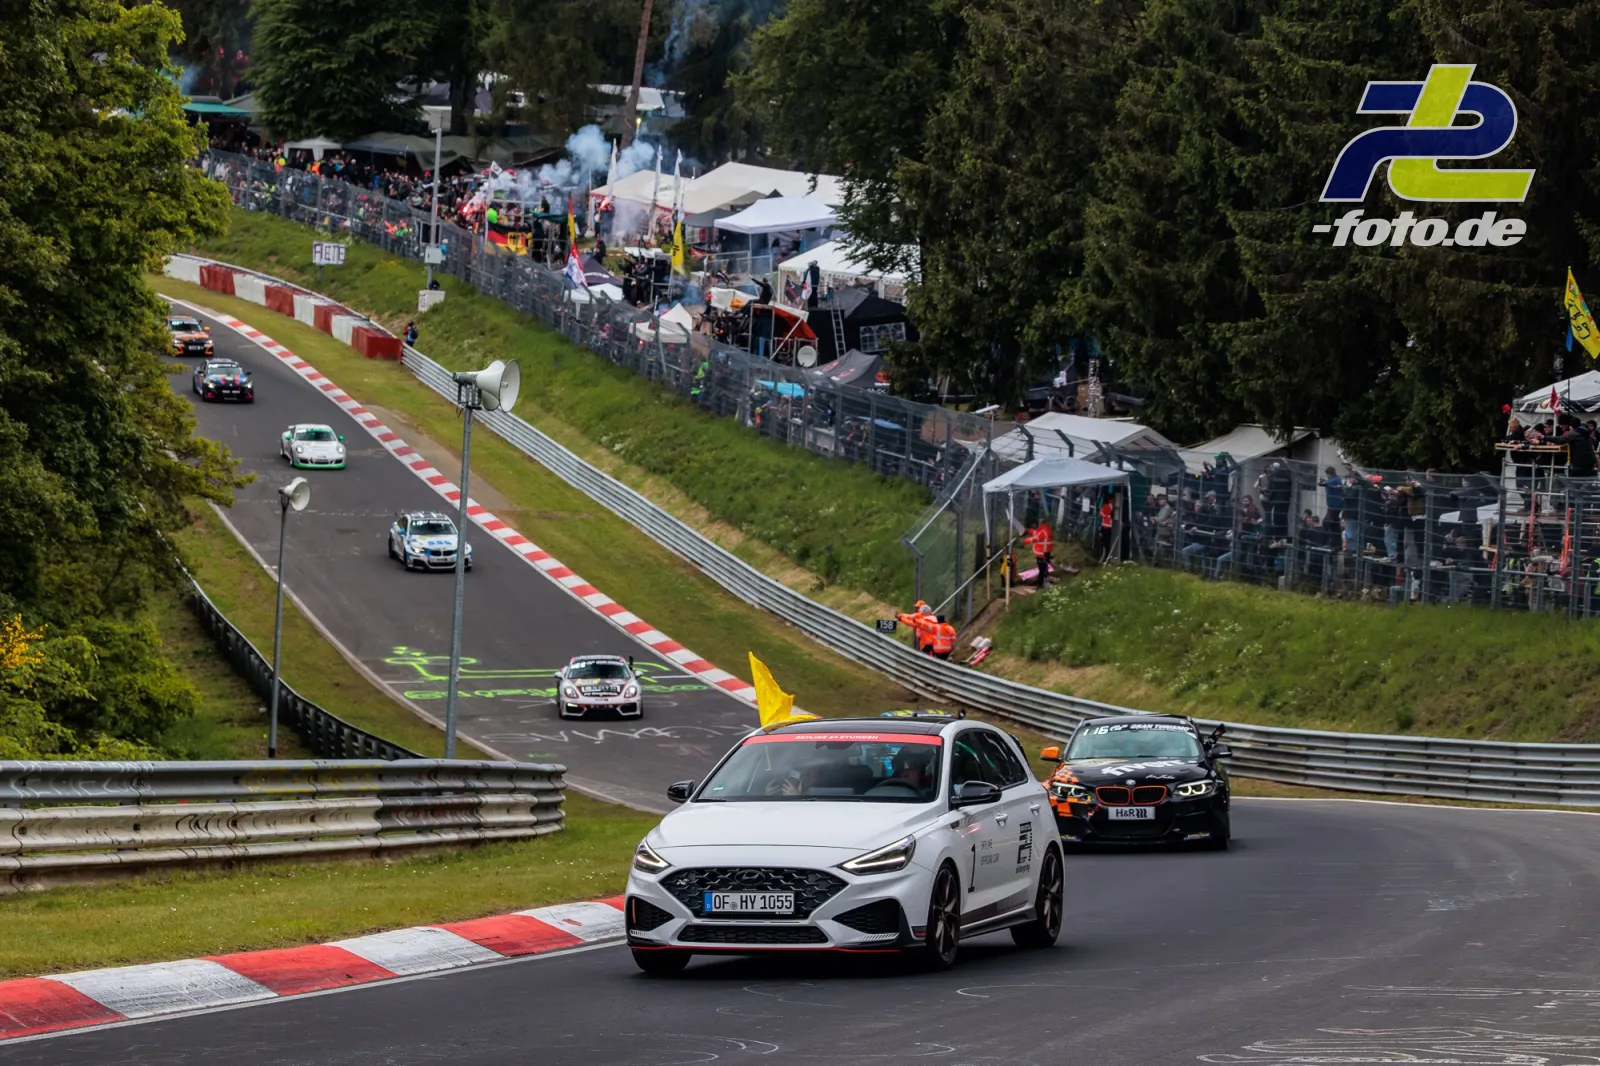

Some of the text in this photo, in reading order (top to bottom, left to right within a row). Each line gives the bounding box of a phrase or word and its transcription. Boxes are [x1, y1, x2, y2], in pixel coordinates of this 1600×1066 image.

[1115, 808, 1136, 818] H&R
[713, 894, 793, 910] OF HY 1055
